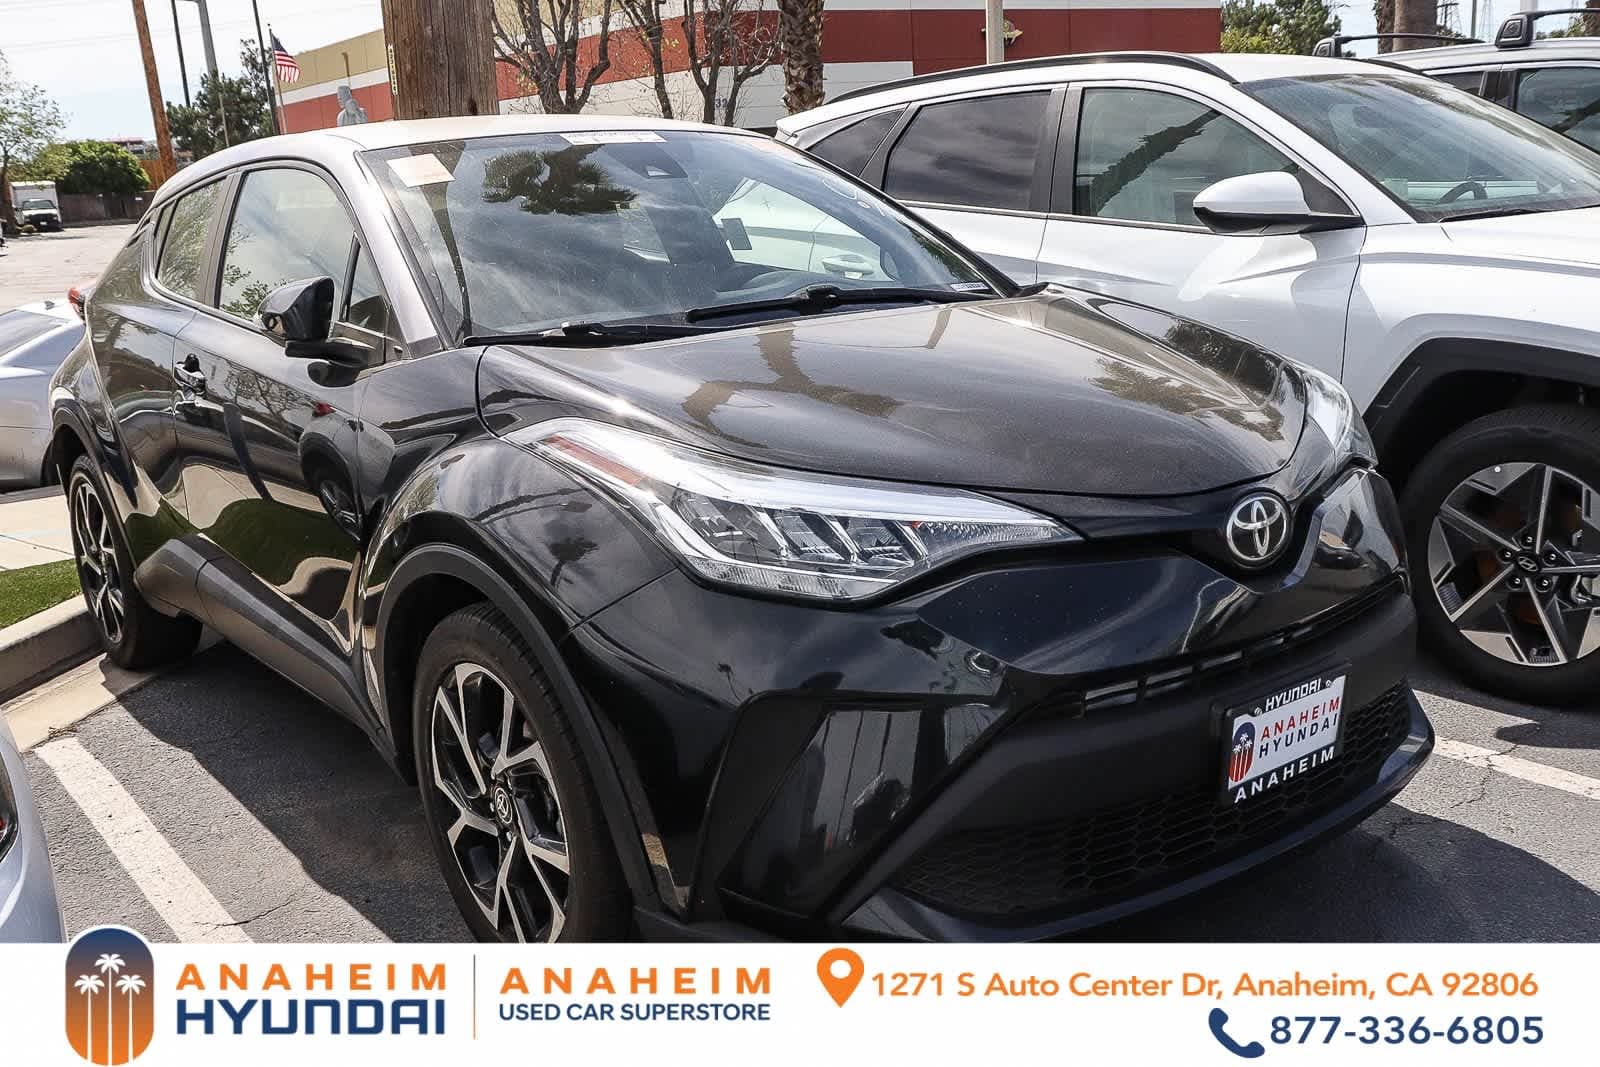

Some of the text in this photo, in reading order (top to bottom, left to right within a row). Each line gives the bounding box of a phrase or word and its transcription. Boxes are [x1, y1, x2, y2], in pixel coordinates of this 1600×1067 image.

[1265, 678, 1322, 711] HYUNDAI
[1258, 713, 1338, 759] HYUNDAI
[1260, 697, 1341, 741] ANAHEIM
[1234, 746, 1336, 804] ANAHEIM
